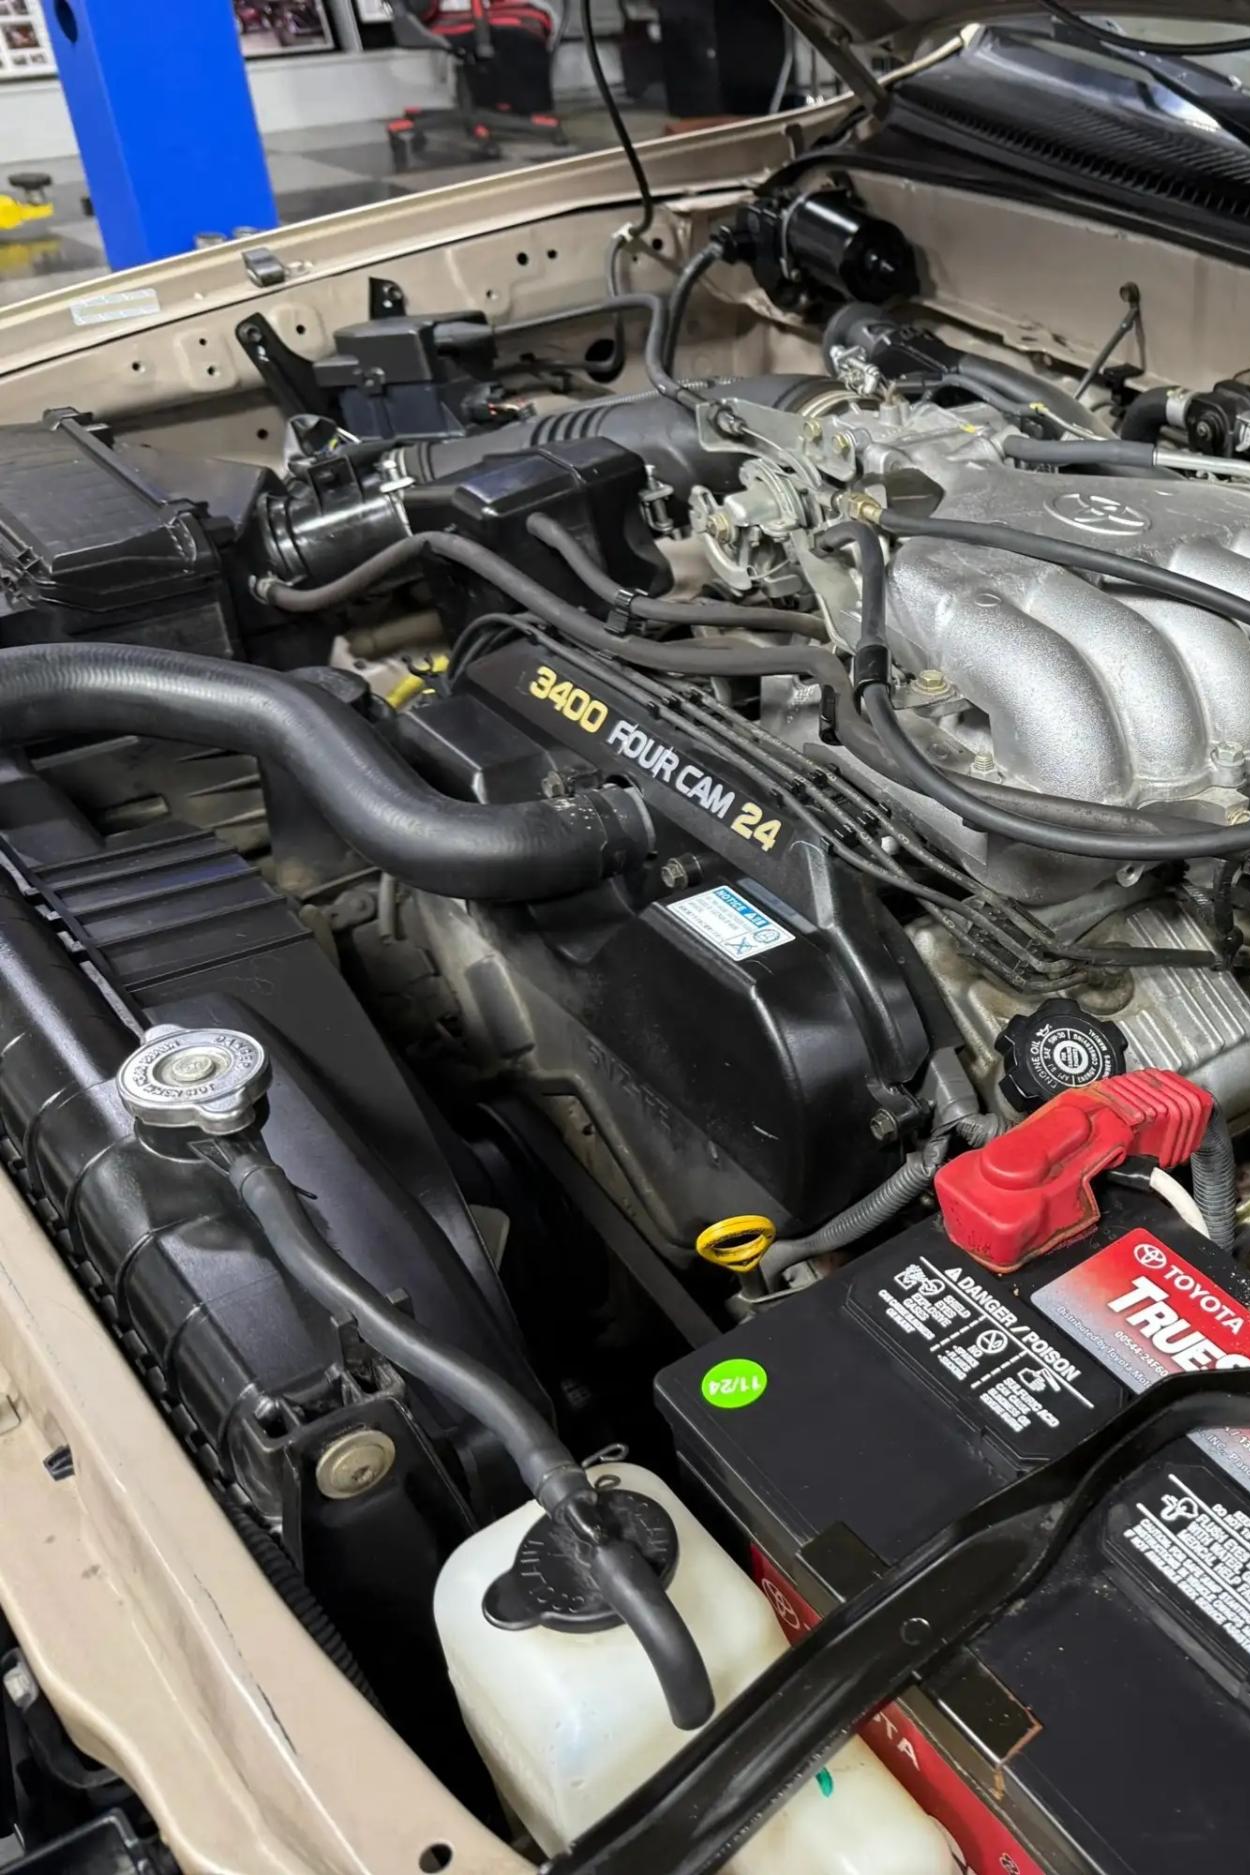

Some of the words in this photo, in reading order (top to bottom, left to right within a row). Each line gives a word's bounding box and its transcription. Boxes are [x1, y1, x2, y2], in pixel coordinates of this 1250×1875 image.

[529, 666, 608, 733] 3400
[606, 720, 680, 782] FOUR
[674, 766, 735, 819] CAM
[731, 802, 782, 851] 24
[1030, 1040, 1040, 1055] OIL
[1031, 1057, 1058, 1089] ENGINE
[903, 1298, 929, 1321] GASES
[911, 1292, 951, 1327] EXPLOSIVE
[934, 1300, 956, 1318] EYES
[941, 1295, 971, 1318] SHIELD
[1164, 1265, 1243, 1334] TOYOTA
[957, 1276, 1018, 1327] DANGER
[1022, 1331, 1081, 1382] POISON
[1057, 1306, 1101, 1343] Distributed
[1095, 1339, 1110, 1351] by
[1105, 1347, 1134, 1372] Toyota
[967, 1345, 983, 1357] NO
[1114, 1331, 1169, 1377] 00544-24F60
[708, 1375, 762, 1395] 11/24
[1001, 1377, 1042, 1412] SULFURIC
[1036, 1409, 1059, 1427] ACID
[1187, 1521, 1213, 1545] WITH
[1212, 1504, 1227, 1517] DO
[1223, 1514, 1243, 1529] NOT
[1195, 1514, 1228, 1543] FLUSH
[1223, 1539, 1250, 1562] EYES
[1177, 1529, 1216, 1566] MEDICAL
[1213, 1562, 1241, 1584] HELP
